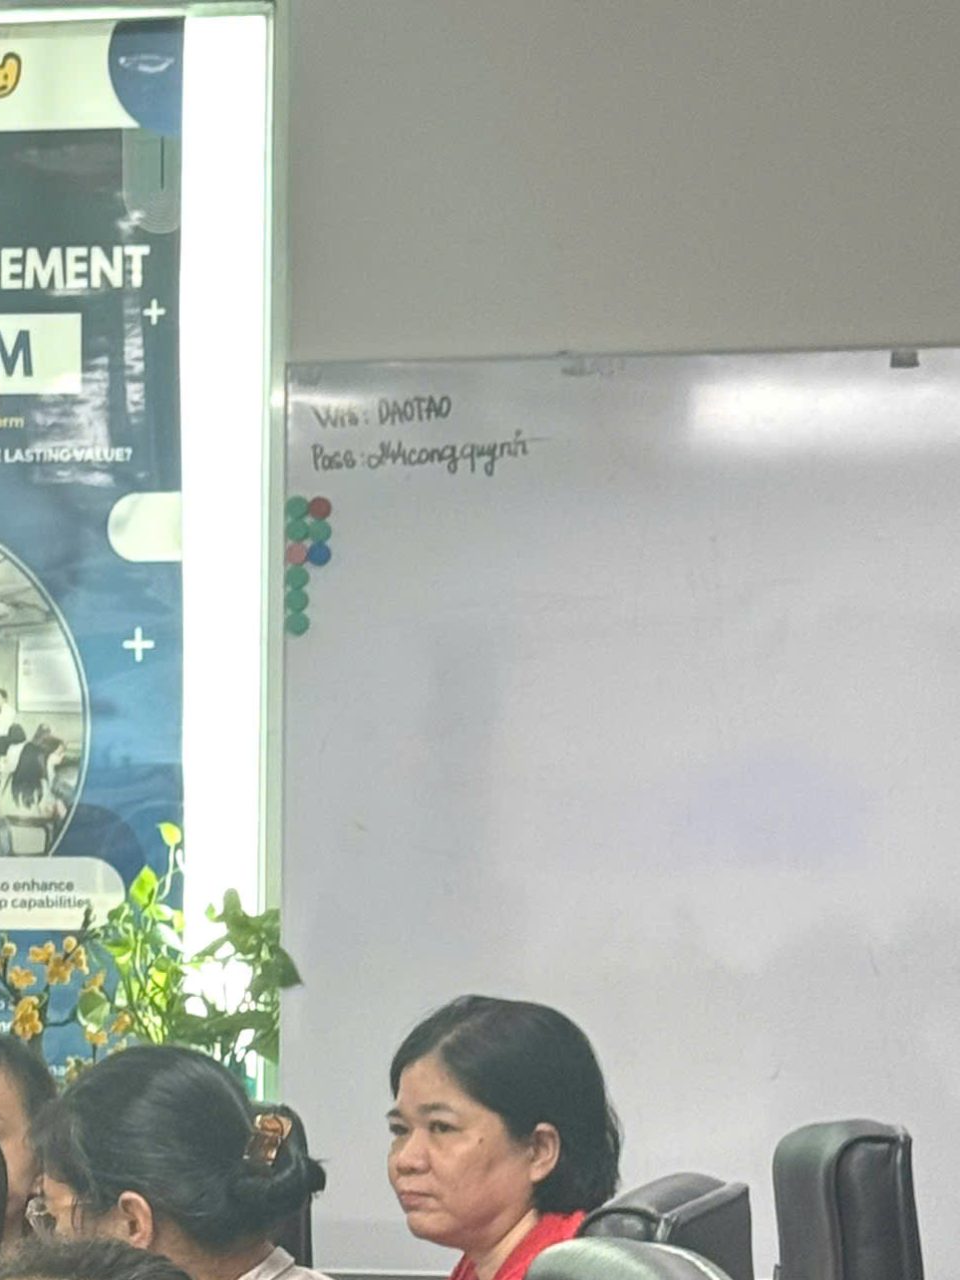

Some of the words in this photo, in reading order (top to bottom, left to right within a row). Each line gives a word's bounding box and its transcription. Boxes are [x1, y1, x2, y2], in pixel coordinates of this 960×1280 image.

[378, 395, 452, 426] DAOTAO
[4, 447, 72, 463] LASTING
[74, 447, 133, 462] VALUE?
[12, 878, 74, 892] enhance
